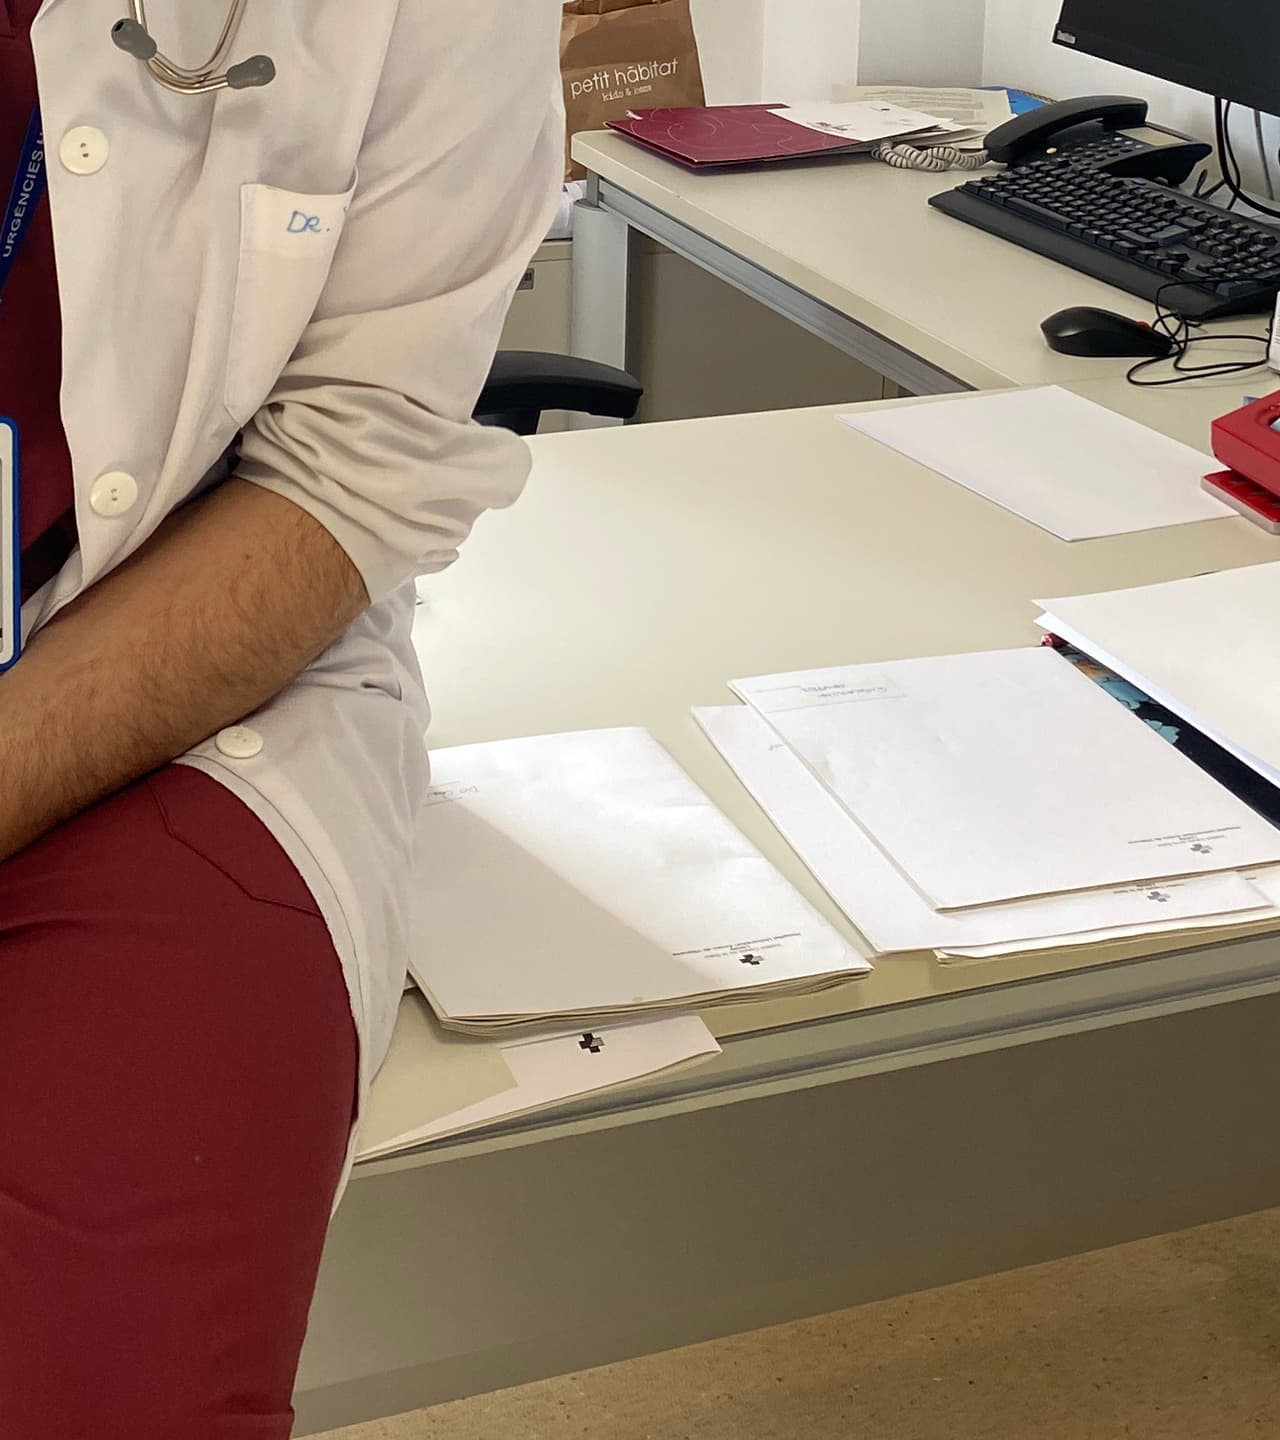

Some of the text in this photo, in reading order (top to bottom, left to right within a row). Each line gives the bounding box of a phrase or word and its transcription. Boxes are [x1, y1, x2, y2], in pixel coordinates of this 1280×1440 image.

[570, 71, 609, 100] petit
[602, 89, 625, 102] kids
[624, 87, 632, 97] &
